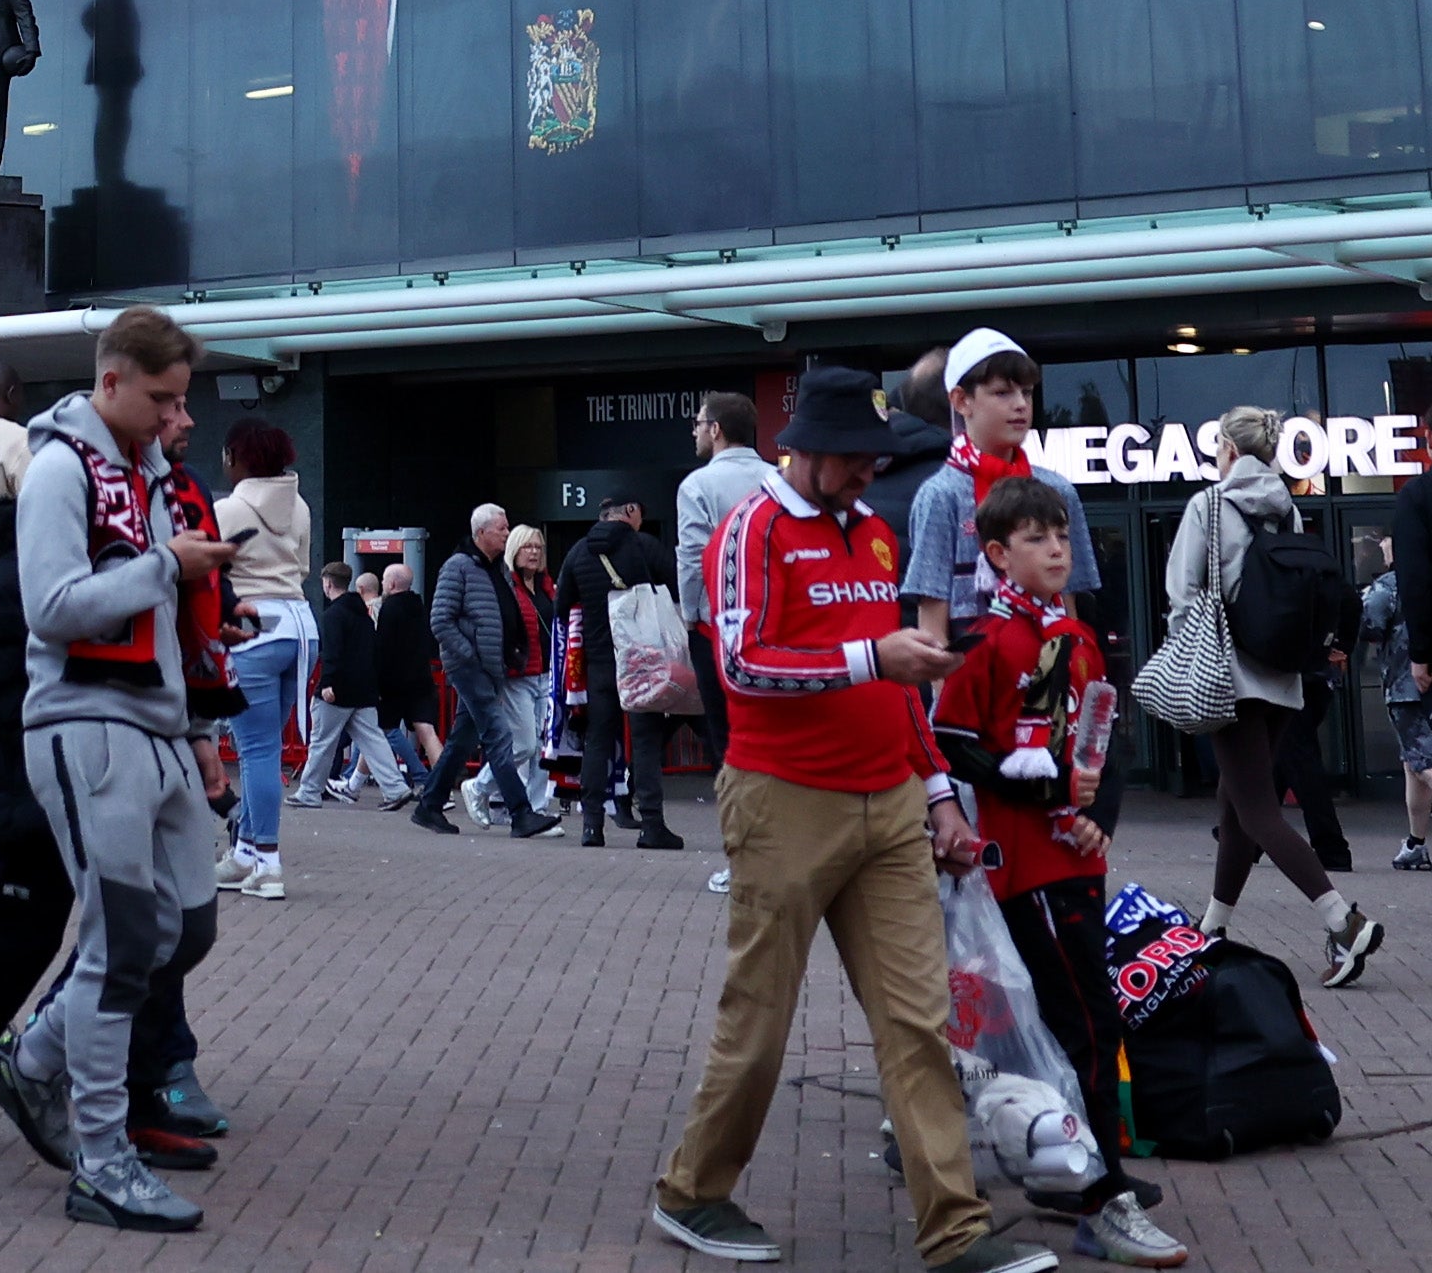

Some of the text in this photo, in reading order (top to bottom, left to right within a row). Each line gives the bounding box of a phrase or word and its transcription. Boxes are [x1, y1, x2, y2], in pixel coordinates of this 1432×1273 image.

[586, 395, 614, 422] THE
[618, 390, 676, 421] TRINITY
[1022, 414, 1424, 485] MEGASORE
[808, 580, 899, 606] SHARP
